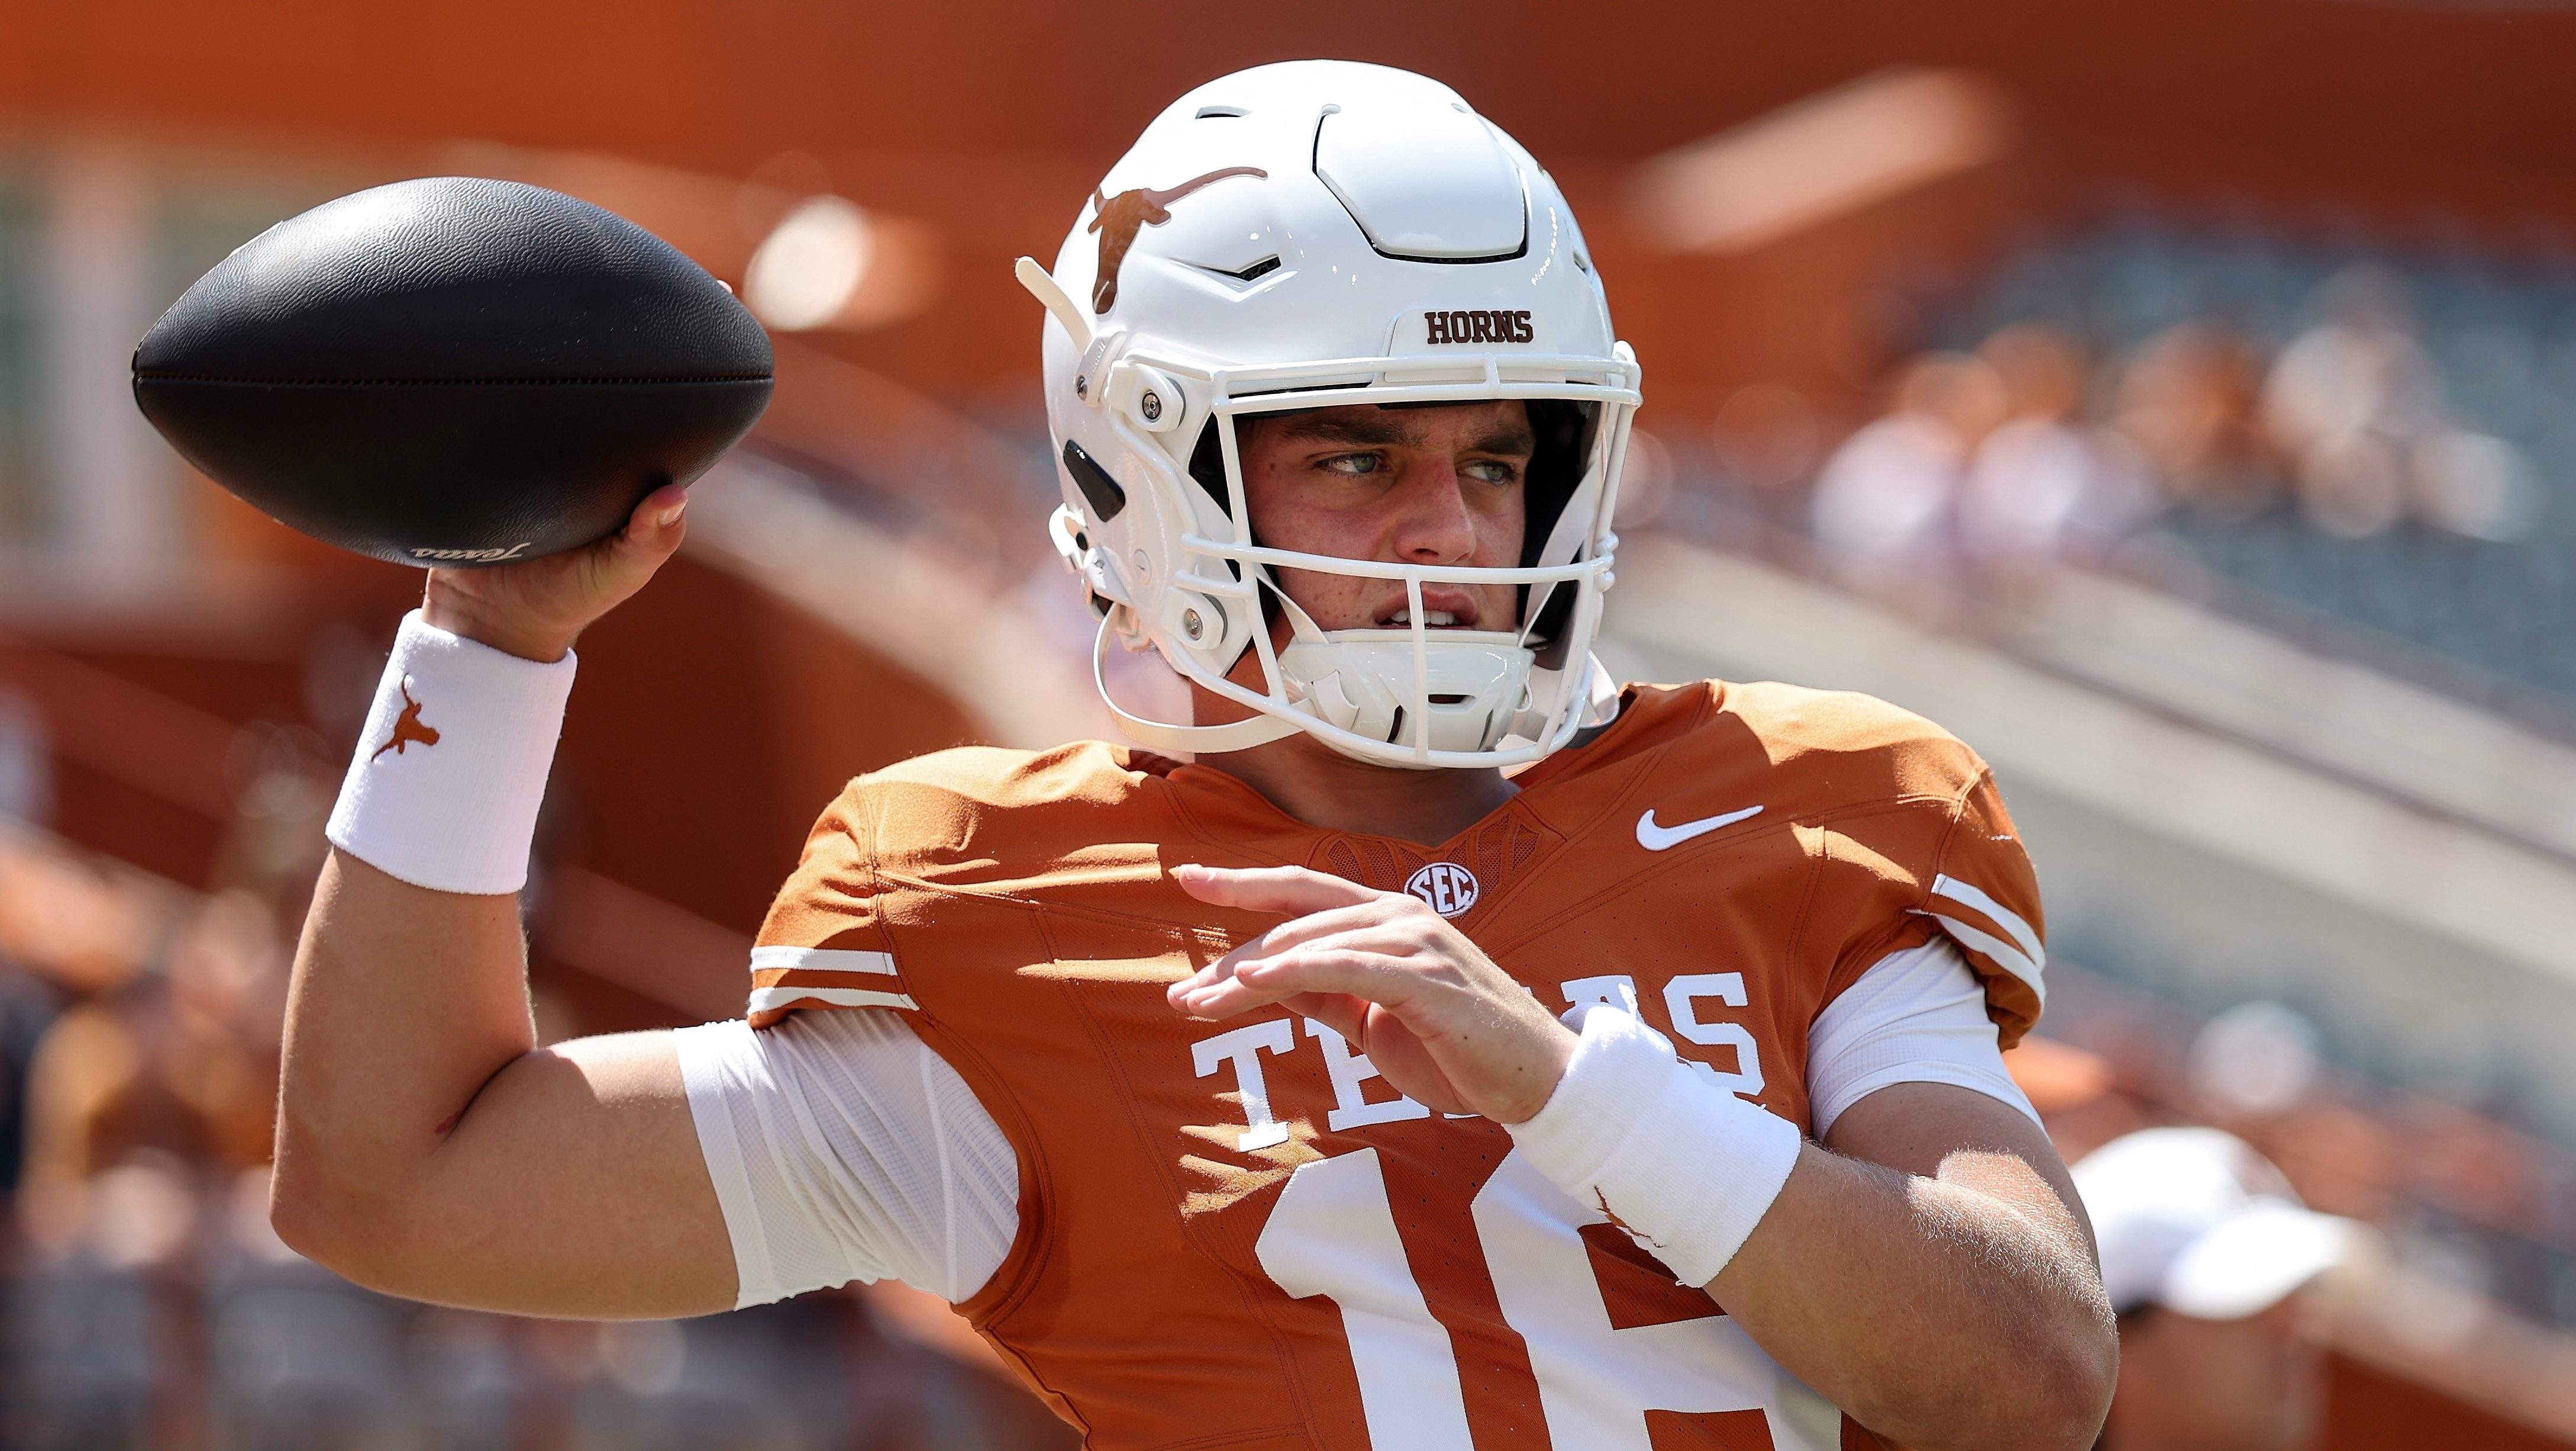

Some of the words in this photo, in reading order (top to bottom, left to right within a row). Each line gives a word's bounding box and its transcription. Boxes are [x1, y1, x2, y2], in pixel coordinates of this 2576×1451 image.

[1424, 311, 1534, 344] HORNS
[1411, 866, 1472, 912] SEC
[1191, 972, 1765, 1152] TES
